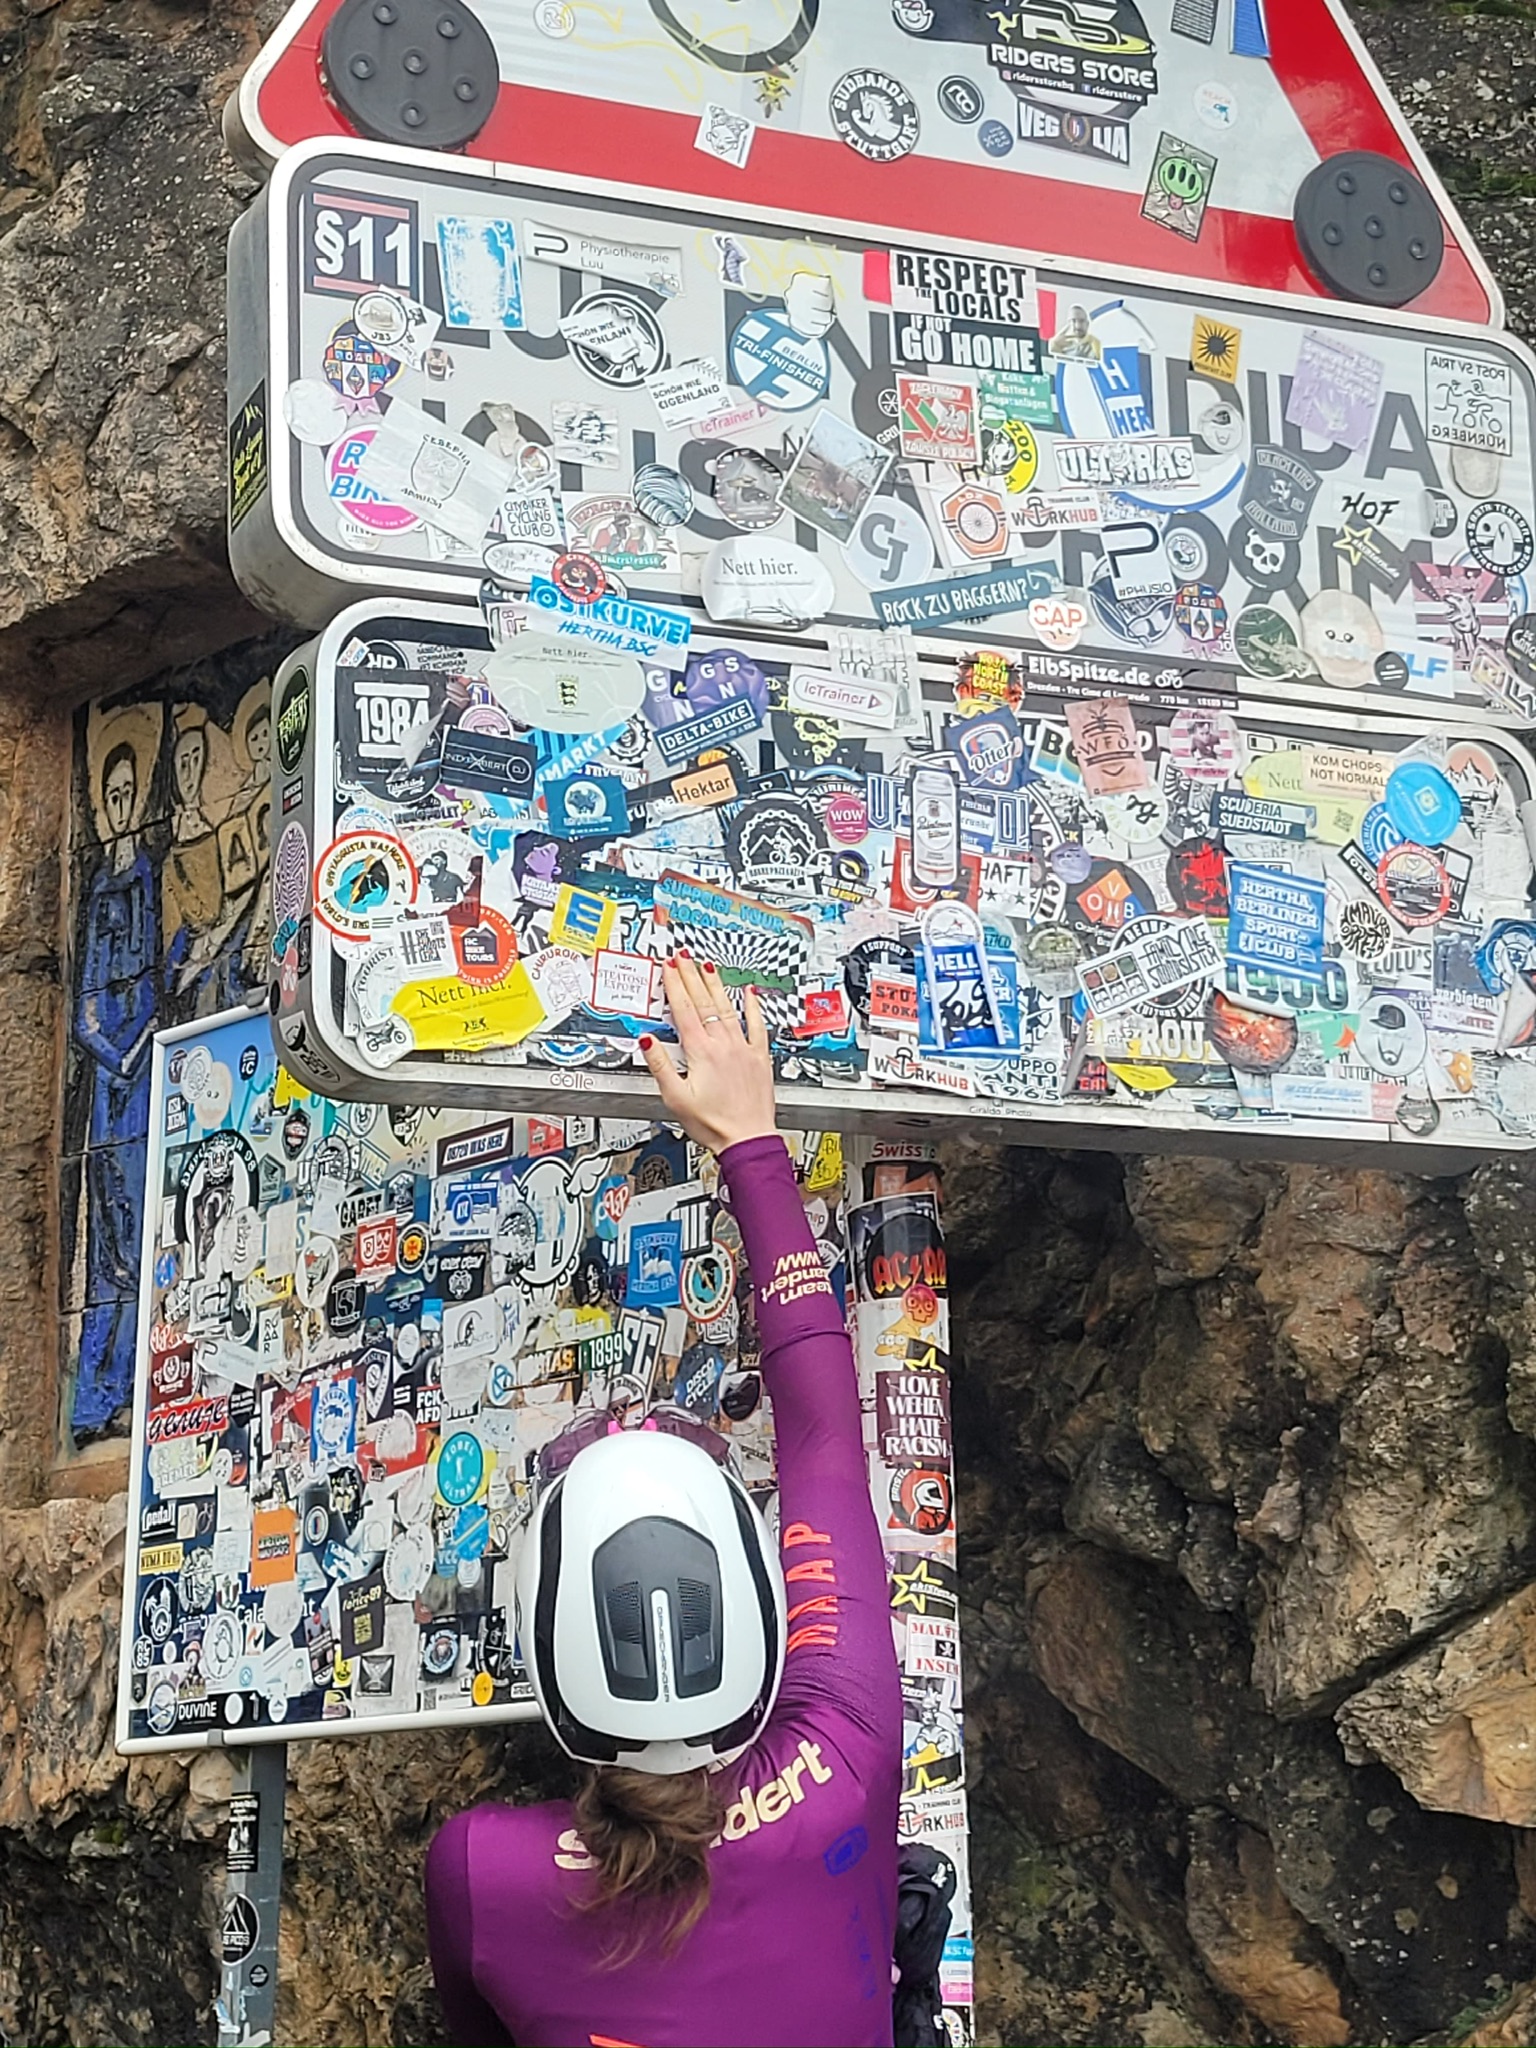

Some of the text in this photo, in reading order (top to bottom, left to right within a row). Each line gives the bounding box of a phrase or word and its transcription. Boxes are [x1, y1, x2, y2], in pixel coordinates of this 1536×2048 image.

[990, 44, 1156, 89] RIDERS STORE
[837, 113, 920, 162] STUTTGART
[580, 240, 671, 264] Physiotherapie
[580, 257, 604, 270] Luu
[896, 254, 1027, 299] RESPECT
[915, 287, 1022, 323] THE LOCALS
[925, 316, 951, 333] NOT
[734, 335, 827, 390] TRI-FINISHER
[780, 345, 824, 372] BERLIN
[901, 326, 1037, 373] GO HOME
[506, 510, 552, 525] CYCLING
[510, 523, 540, 538] CLUB
[721, 558, 798, 576] Nett hier.
[924, 592, 951, 617] ZU
[950, 578, 1028, 612] BAGGERN?
[534, 584, 685, 646] OSTKURVE
[556, 620, 659, 658] HERTHA BSC
[1028, 656, 1152, 687] ElbSpitze.de
[664, 705, 750, 750] DELTA-BIKE
[1310, 768, 1387, 787] NOT NORMAL
[1312, 755, 1383, 773] KOM CHOPS
[675, 775, 731, 802] Hektar
[831, 807, 865, 823] WOW
[1218, 795, 1282, 818] SCUDERIA
[1218, 812, 1292, 836] SUEDSTADT
[660, 877, 734, 917] SUPPORT
[1240, 878, 1315, 911] HERTHA,
[1237, 897, 1318, 930] BERLINER
[1244, 918, 1309, 943] SPORT-
[1256, 938, 1296, 960] CLUB
[418, 982, 464, 1009] Nett
[871, 1142, 922, 1159] Swiss
[588, 1334, 624, 1369] 1899
[685, 1356, 715, 1394] DISCO
[899, 1375, 942, 1397] LOVE
[415, 1407, 441, 1425] AFD
[899, 1417, 942, 1438] HATE
[179, 1701, 218, 1721] DUVINE
